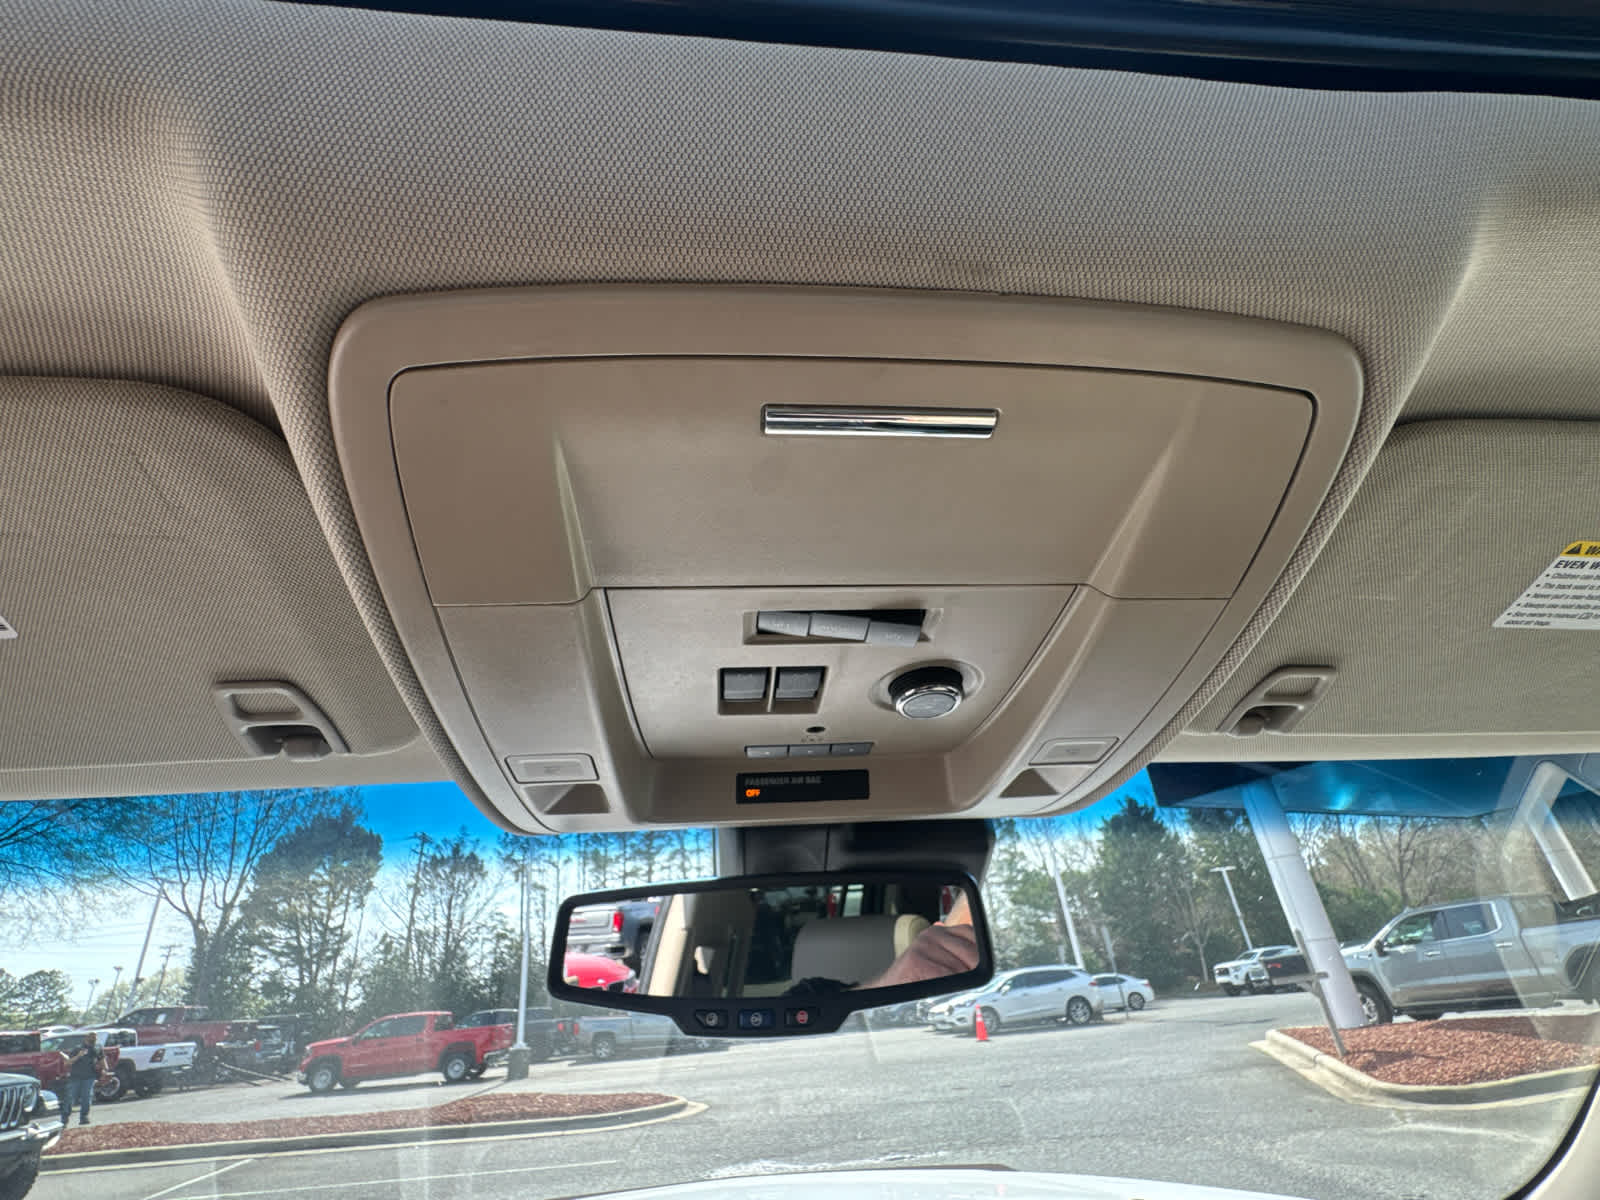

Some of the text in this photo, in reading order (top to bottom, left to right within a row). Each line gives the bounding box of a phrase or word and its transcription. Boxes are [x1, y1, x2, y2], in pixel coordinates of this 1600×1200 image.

[1553, 560, 1589, 569] EVEN
[745, 775, 821, 785] PASSENGER AIR BAG
[745, 788, 761, 798] OFF
